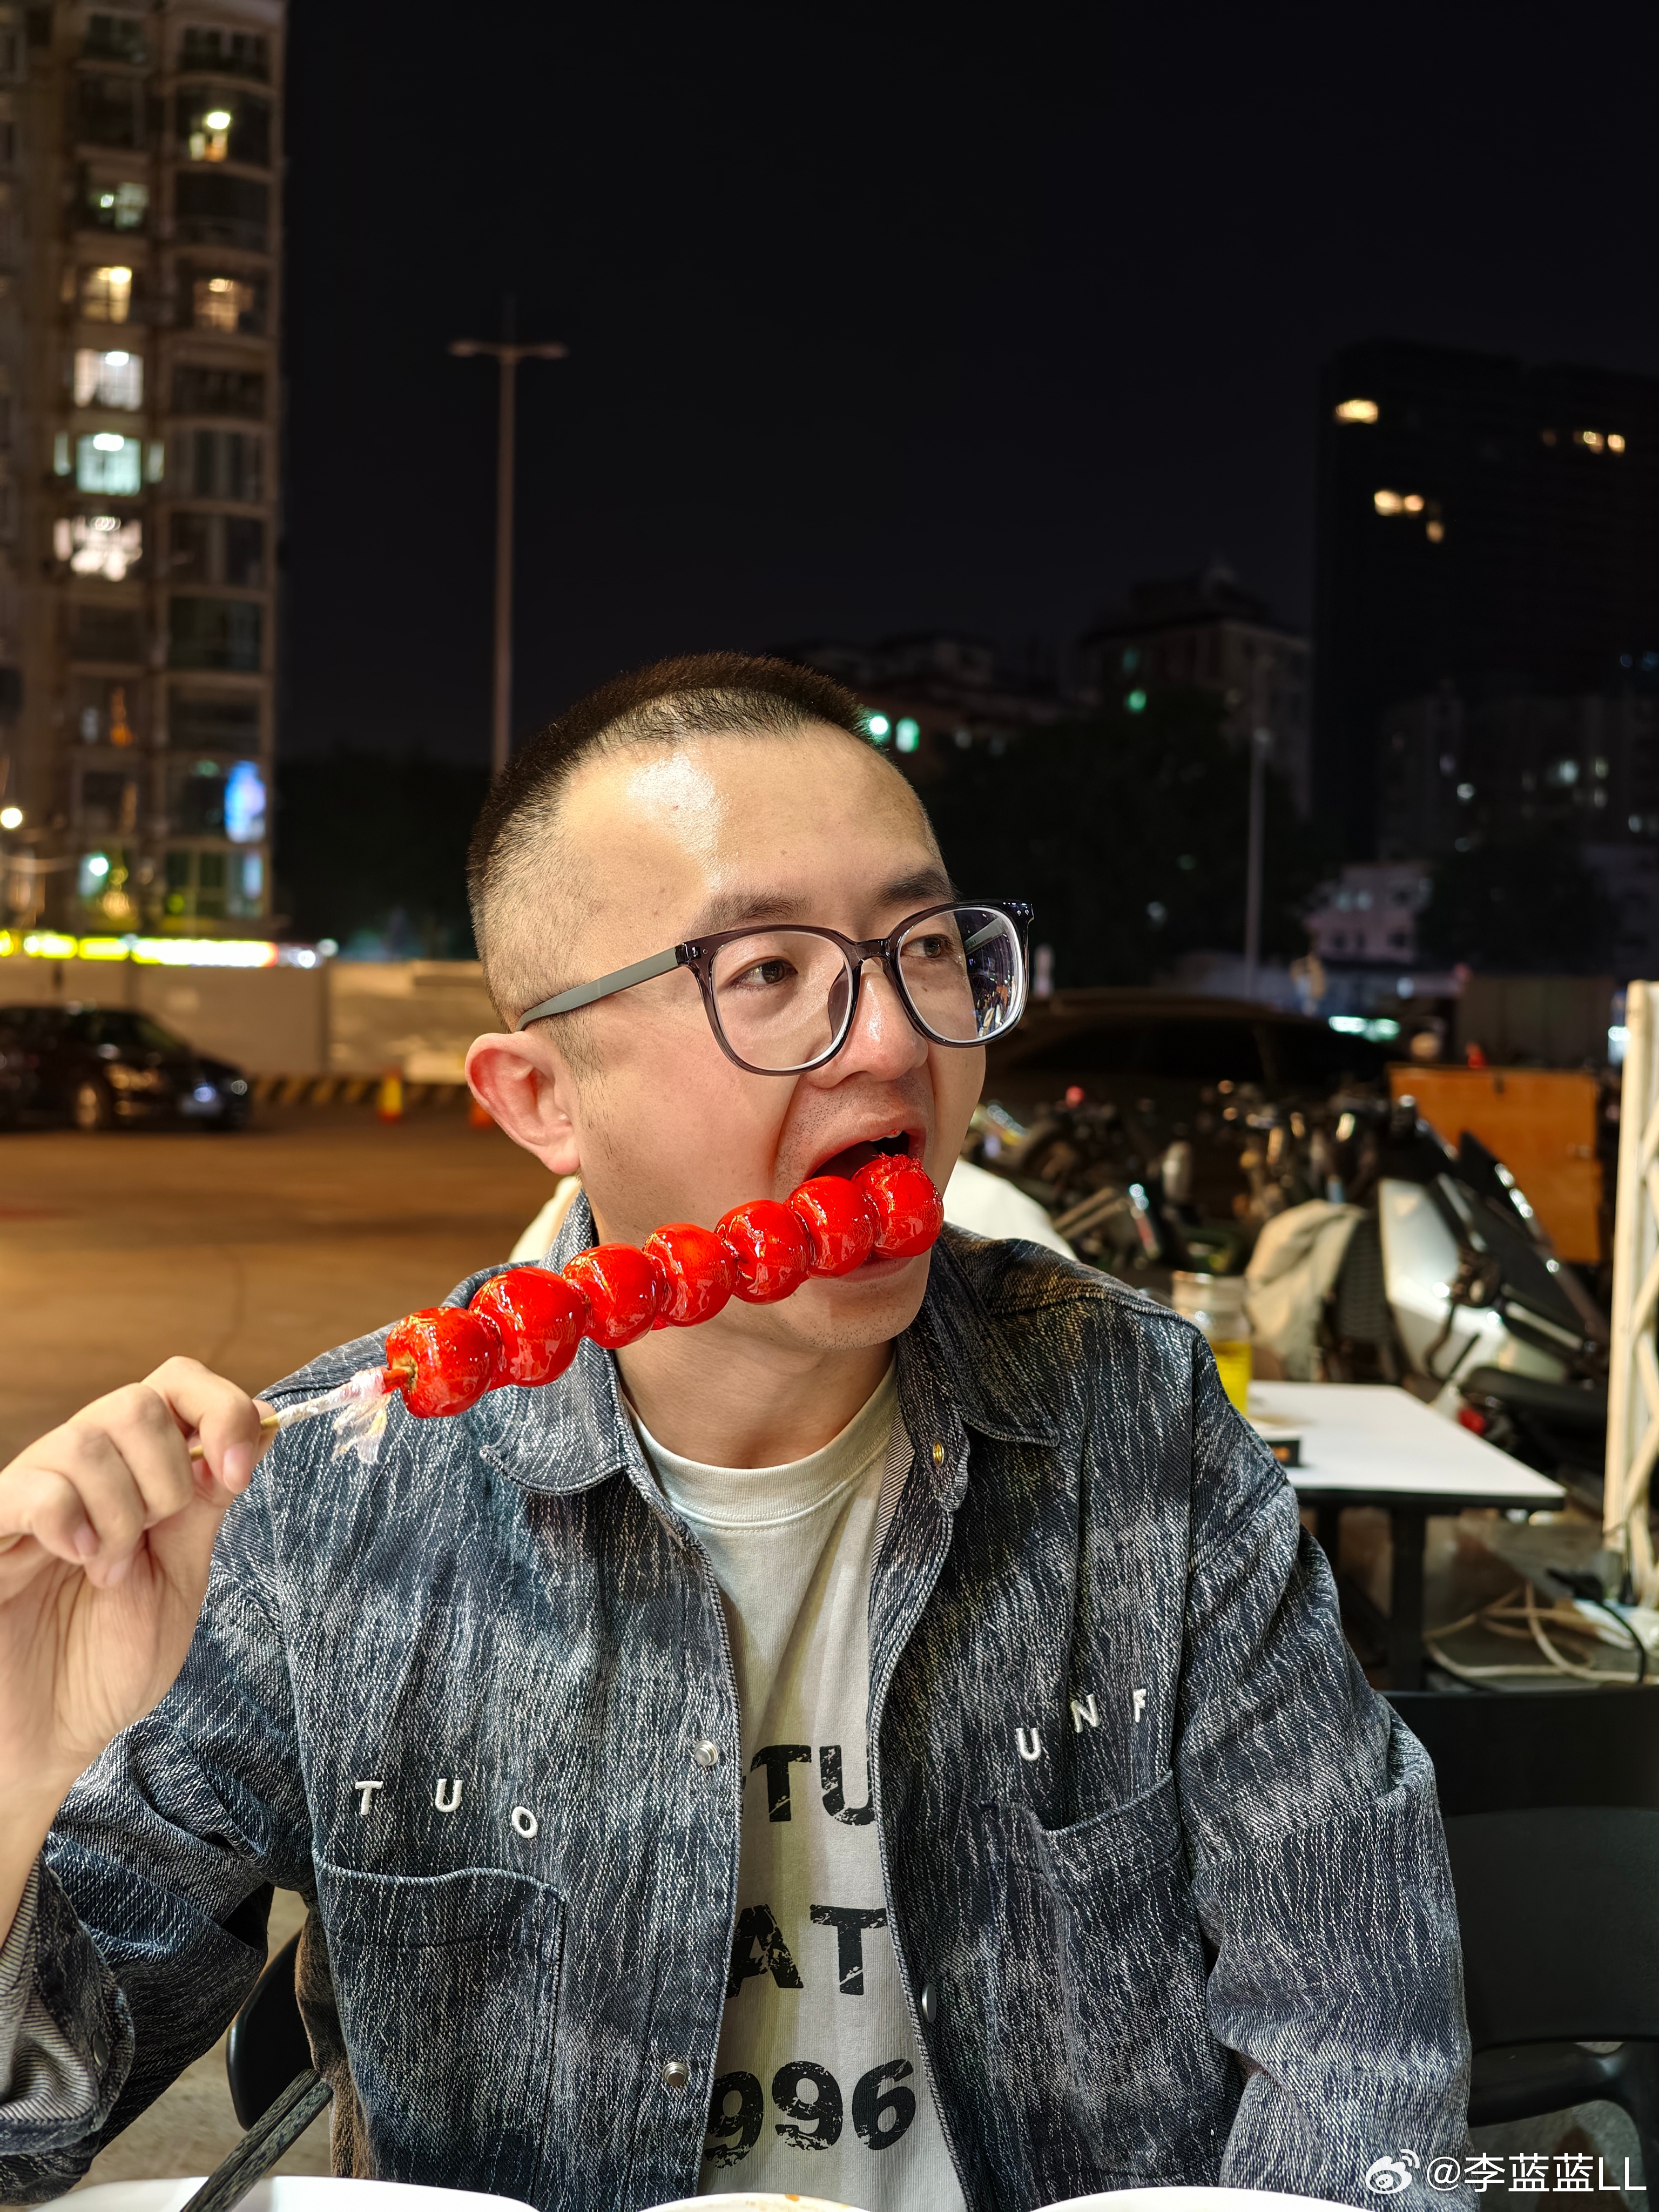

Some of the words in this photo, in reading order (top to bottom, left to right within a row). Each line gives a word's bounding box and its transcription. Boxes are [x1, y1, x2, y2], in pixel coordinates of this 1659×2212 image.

[742, 1744, 876, 1826] TU
[725, 1904, 888, 1999] AT
[703, 2059, 916, 2169] 996
